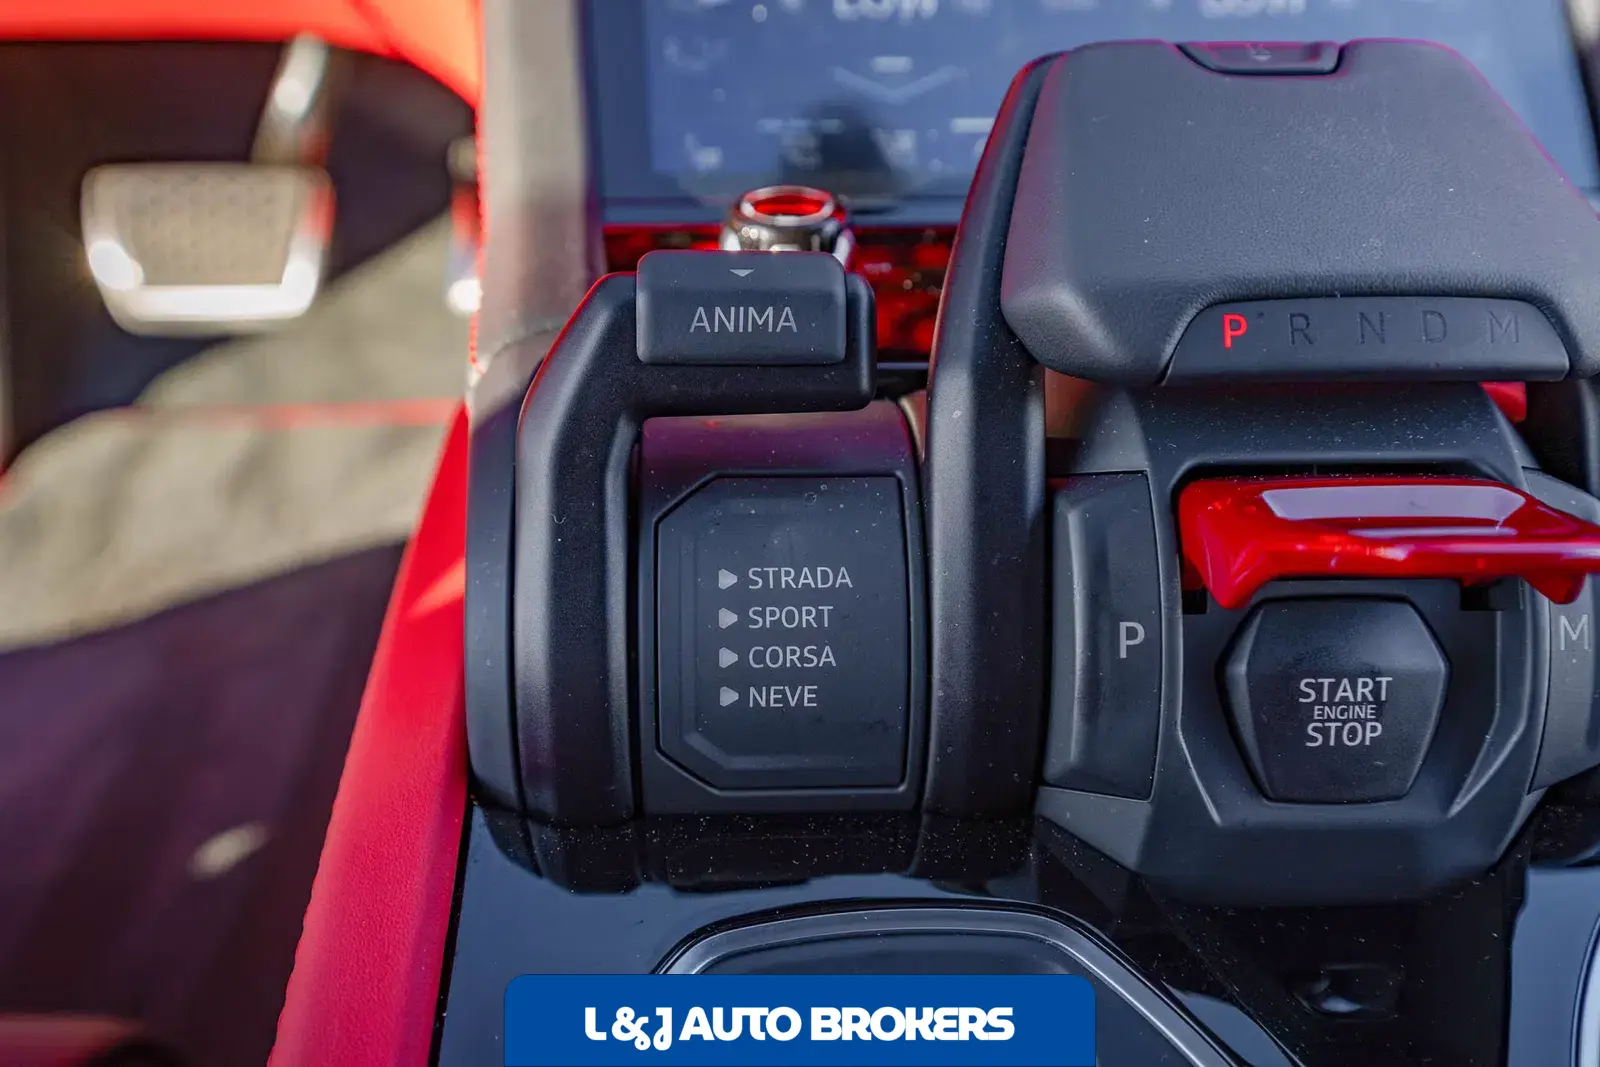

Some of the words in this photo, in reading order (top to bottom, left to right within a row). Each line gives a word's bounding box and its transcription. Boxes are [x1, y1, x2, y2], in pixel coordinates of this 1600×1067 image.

[689, 306, 798, 333] ANIMA
[1223, 313, 1248, 349] P
[1288, 312, 1314, 345] R
[1357, 311, 1386, 345] N
[1421, 309, 1447, 344] D
[1487, 309, 1520, 344] M
[748, 566, 853, 589] STRADA
[748, 605, 834, 629] SPORT
[1118, 621, 1145, 659] P
[1559, 613, 1590, 652] M
[748, 645, 837, 668] CORSA
[749, 685, 818, 708] NEVE
[1298, 676, 1393, 703] START
[1313, 704, 1378, 720] ENGINE
[1305, 721, 1383, 747] STOP
